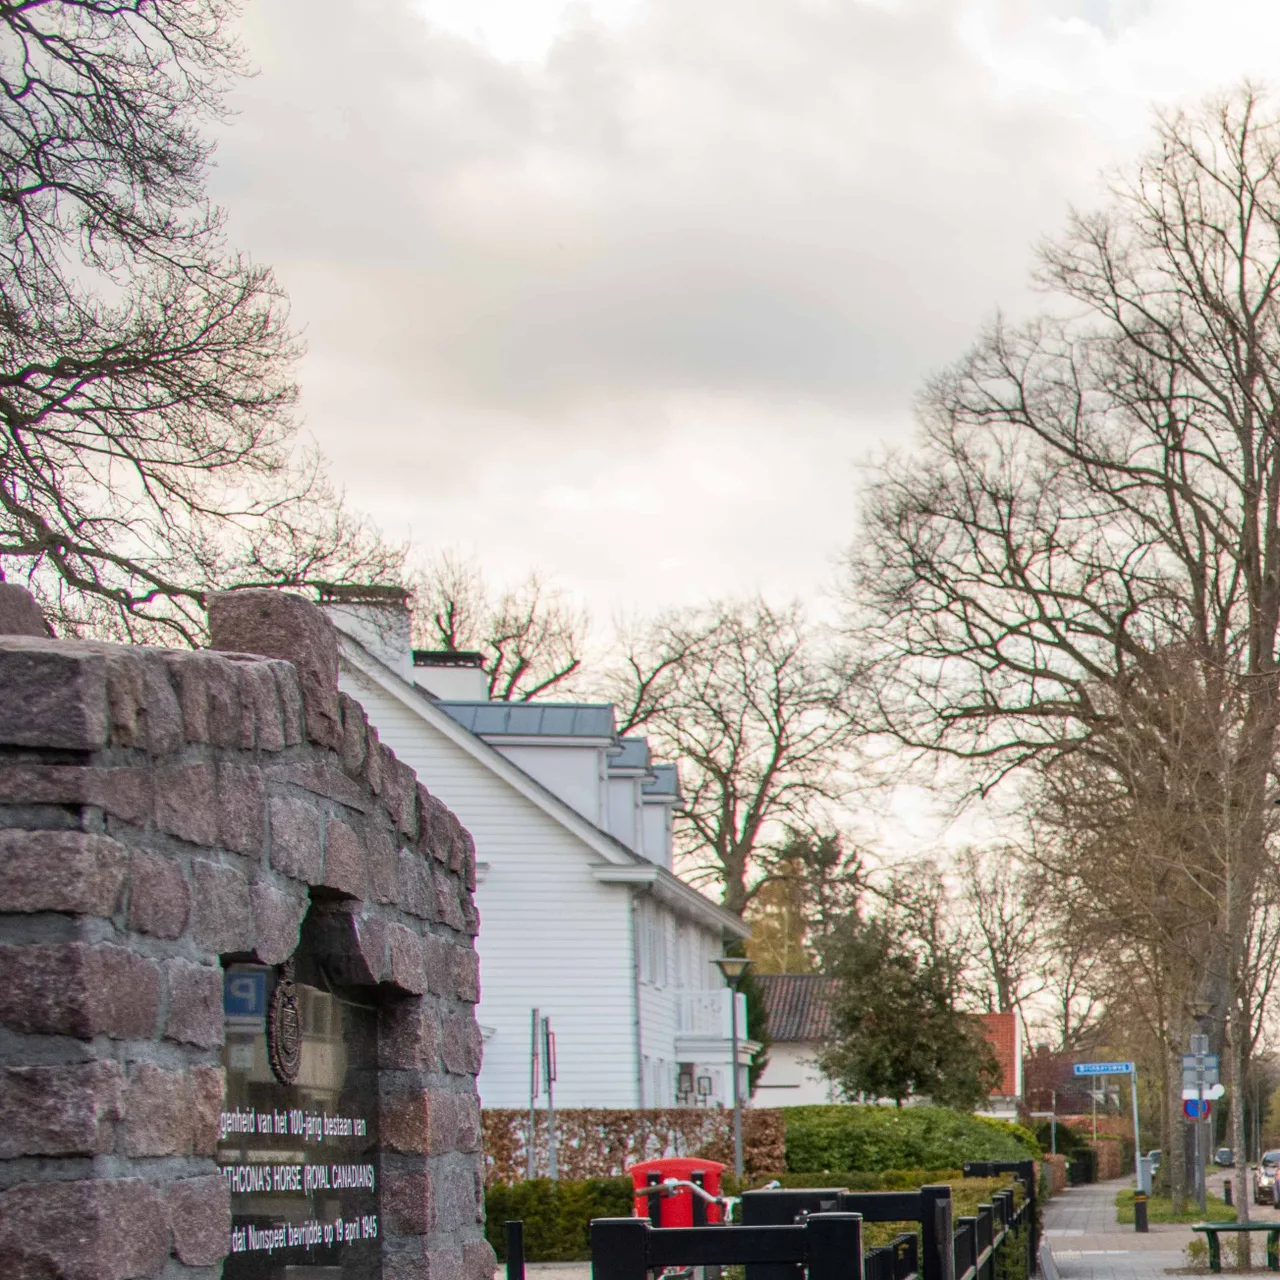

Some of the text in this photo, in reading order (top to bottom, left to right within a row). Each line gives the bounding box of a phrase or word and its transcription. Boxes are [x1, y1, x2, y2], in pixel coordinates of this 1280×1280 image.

[257, 1113, 273, 1133] van
[274, 1108, 288, 1134] het
[289, 1109, 322, 1141] 100-jarig
[323, 1111, 353, 1136] bestaan
[353, 1118, 367, 1136] van
[217, 1164, 375, 1196] THCONA'S HORSE (ROYAL CANADIANS)
[232, 1214, 378, 1255] dat Nunspeet bevrijdde op 19 april 1945
